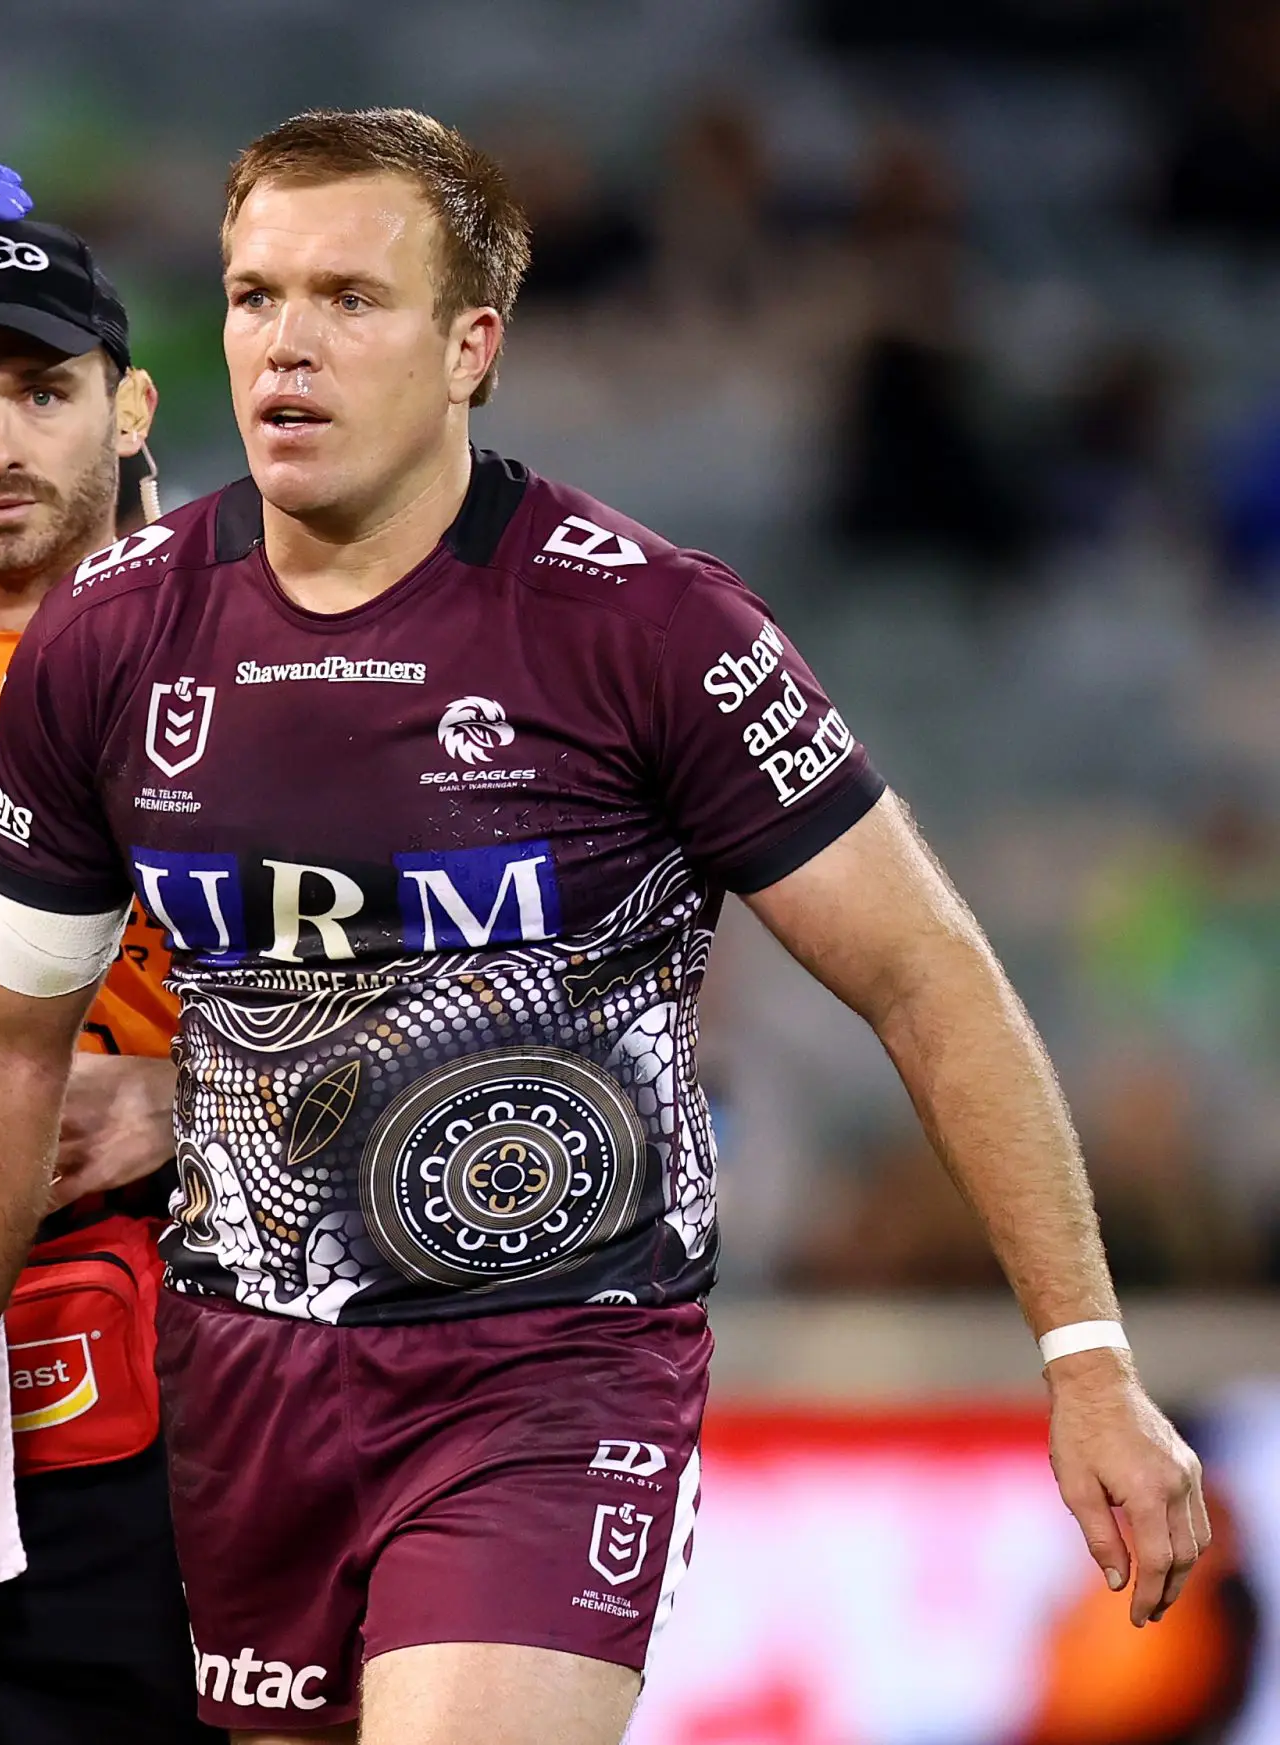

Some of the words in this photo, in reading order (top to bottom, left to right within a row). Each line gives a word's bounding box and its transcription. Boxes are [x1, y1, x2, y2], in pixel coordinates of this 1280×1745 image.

[72, 552, 170, 598] DYNASTY
[533, 554, 628, 585] DYNASTY
[703, 619, 784, 714] Shaw
[743, 669, 809, 757] and
[420, 771, 459, 785] SEA
[462, 769, 536, 782] EAGLES
[141, 787, 157, 798] NRL
[158, 789, 193, 801] TELSTRA
[439, 784, 466, 793] MANLY
[134, 797, 202, 814] PREMIERSHIP
[586, 1470, 663, 1492] DYNASTY
[583, 1589, 600, 1601] NRL
[572, 1597, 640, 1619] PREMIERSHIP
[194, 1647, 328, 1711] ntac
